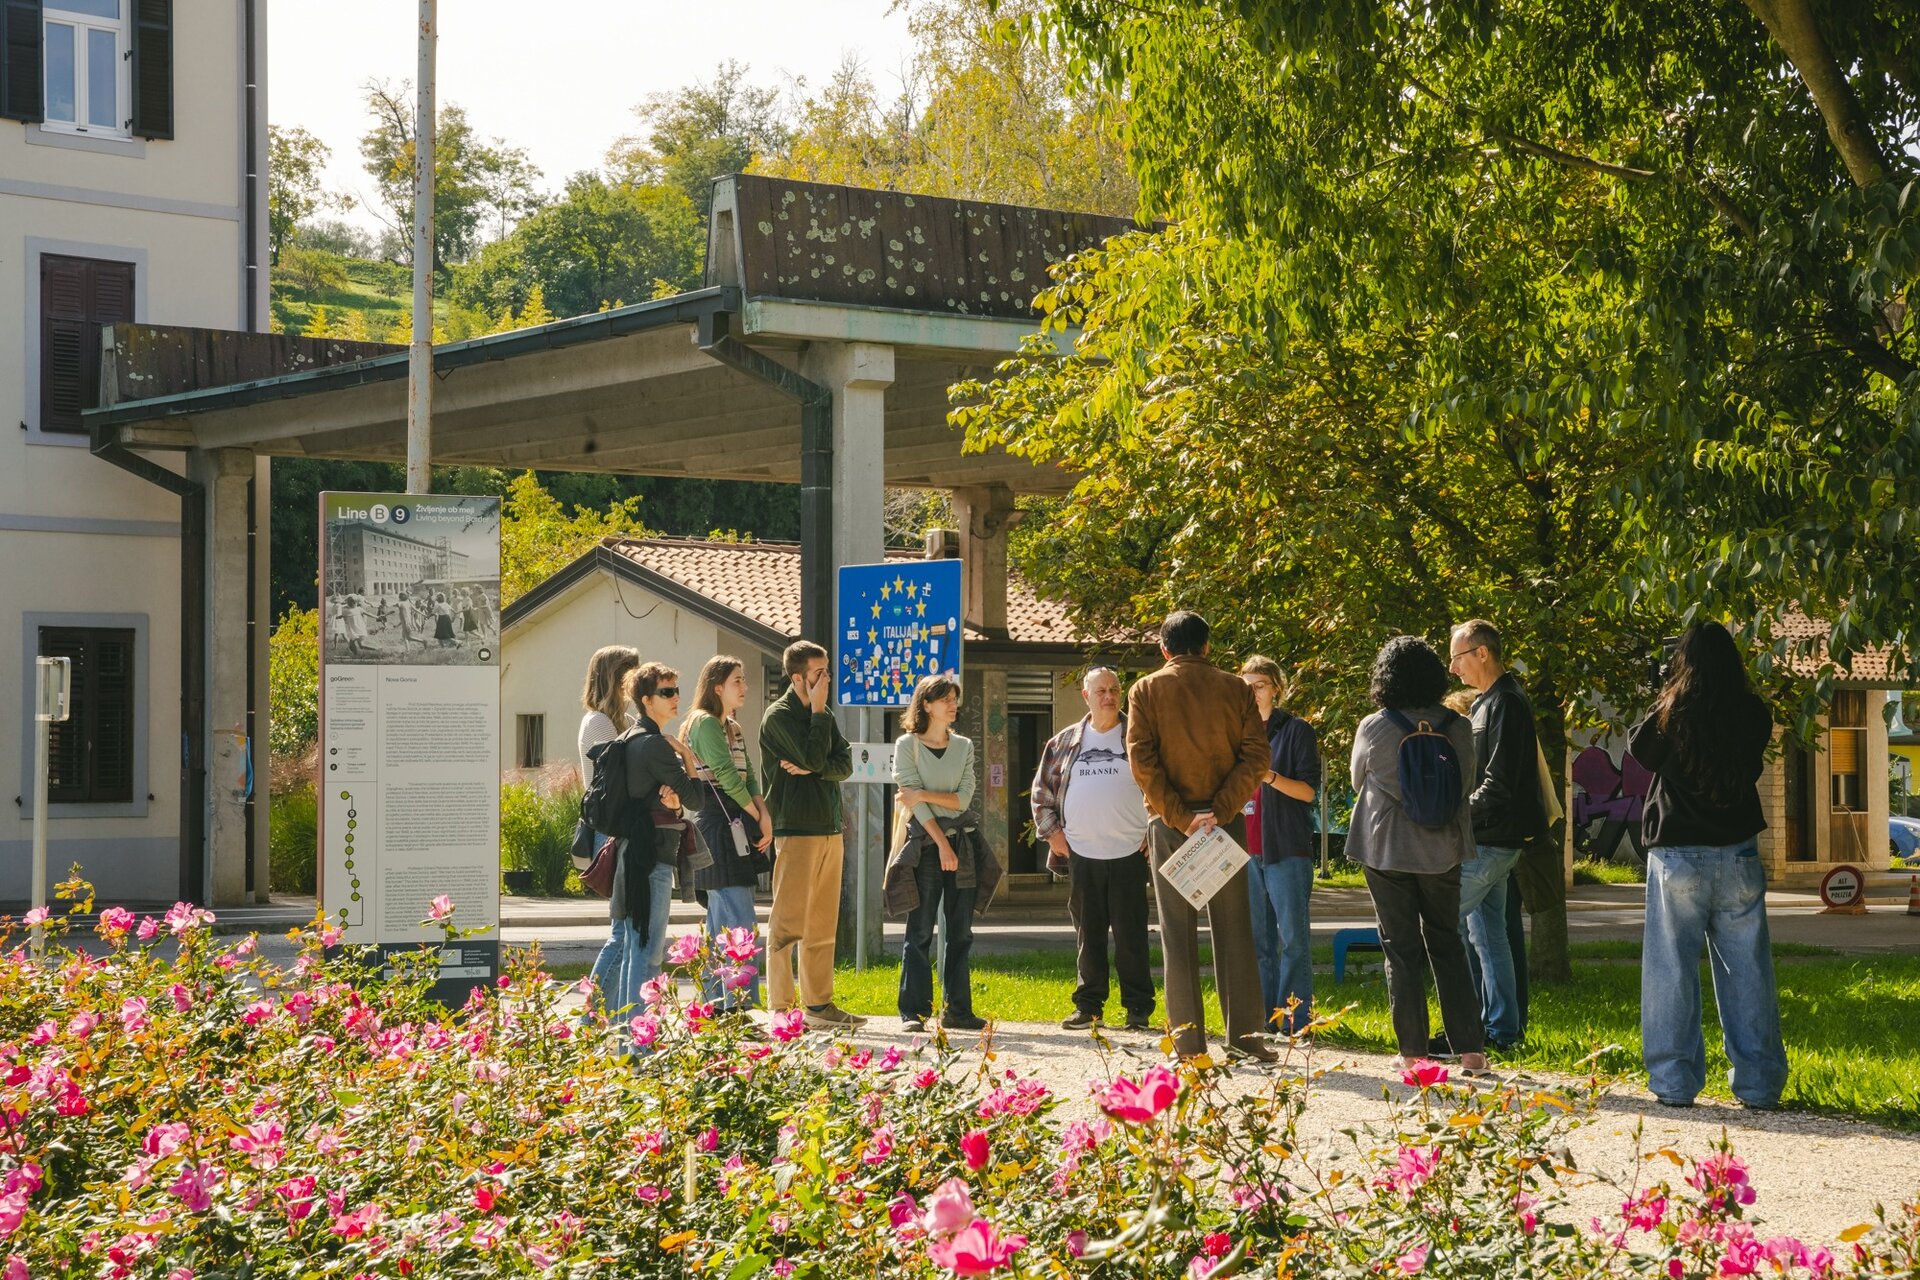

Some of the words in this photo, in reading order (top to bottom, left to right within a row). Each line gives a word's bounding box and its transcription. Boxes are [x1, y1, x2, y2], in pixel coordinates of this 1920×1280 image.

[338, 507, 368, 520] Line
[447, 505, 458, 513] ob
[416, 514, 437, 524] Living
[438, 515, 464, 524] beyond
[883, 625, 912, 639] ITALIJA
[1175, 859, 1184, 868] IL
[1183, 836, 1207, 862] PICCOLO
